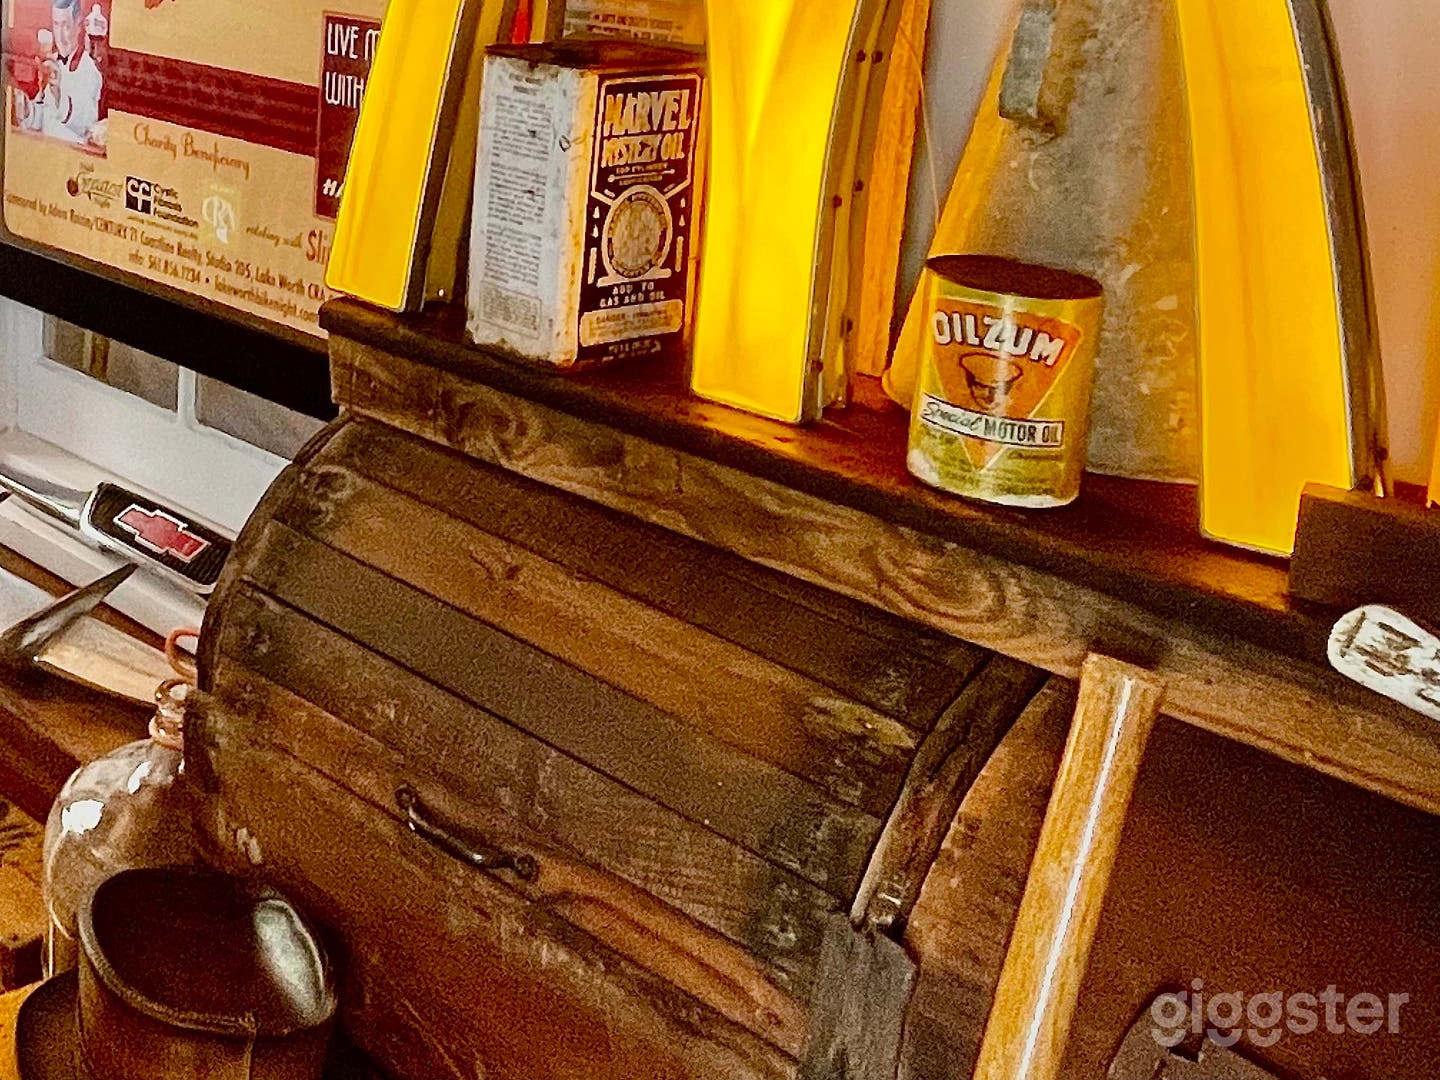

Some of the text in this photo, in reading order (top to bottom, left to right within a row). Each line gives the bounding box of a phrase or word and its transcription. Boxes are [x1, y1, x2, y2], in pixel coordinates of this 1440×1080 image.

[327, 23, 360, 60] LIVE
[603, 89, 692, 136] MARVEL
[932, 311, 1065, 366] OILZUM
[983, 420, 1036, 444] MOTOR
[1041, 425, 1060, 444] OIL
